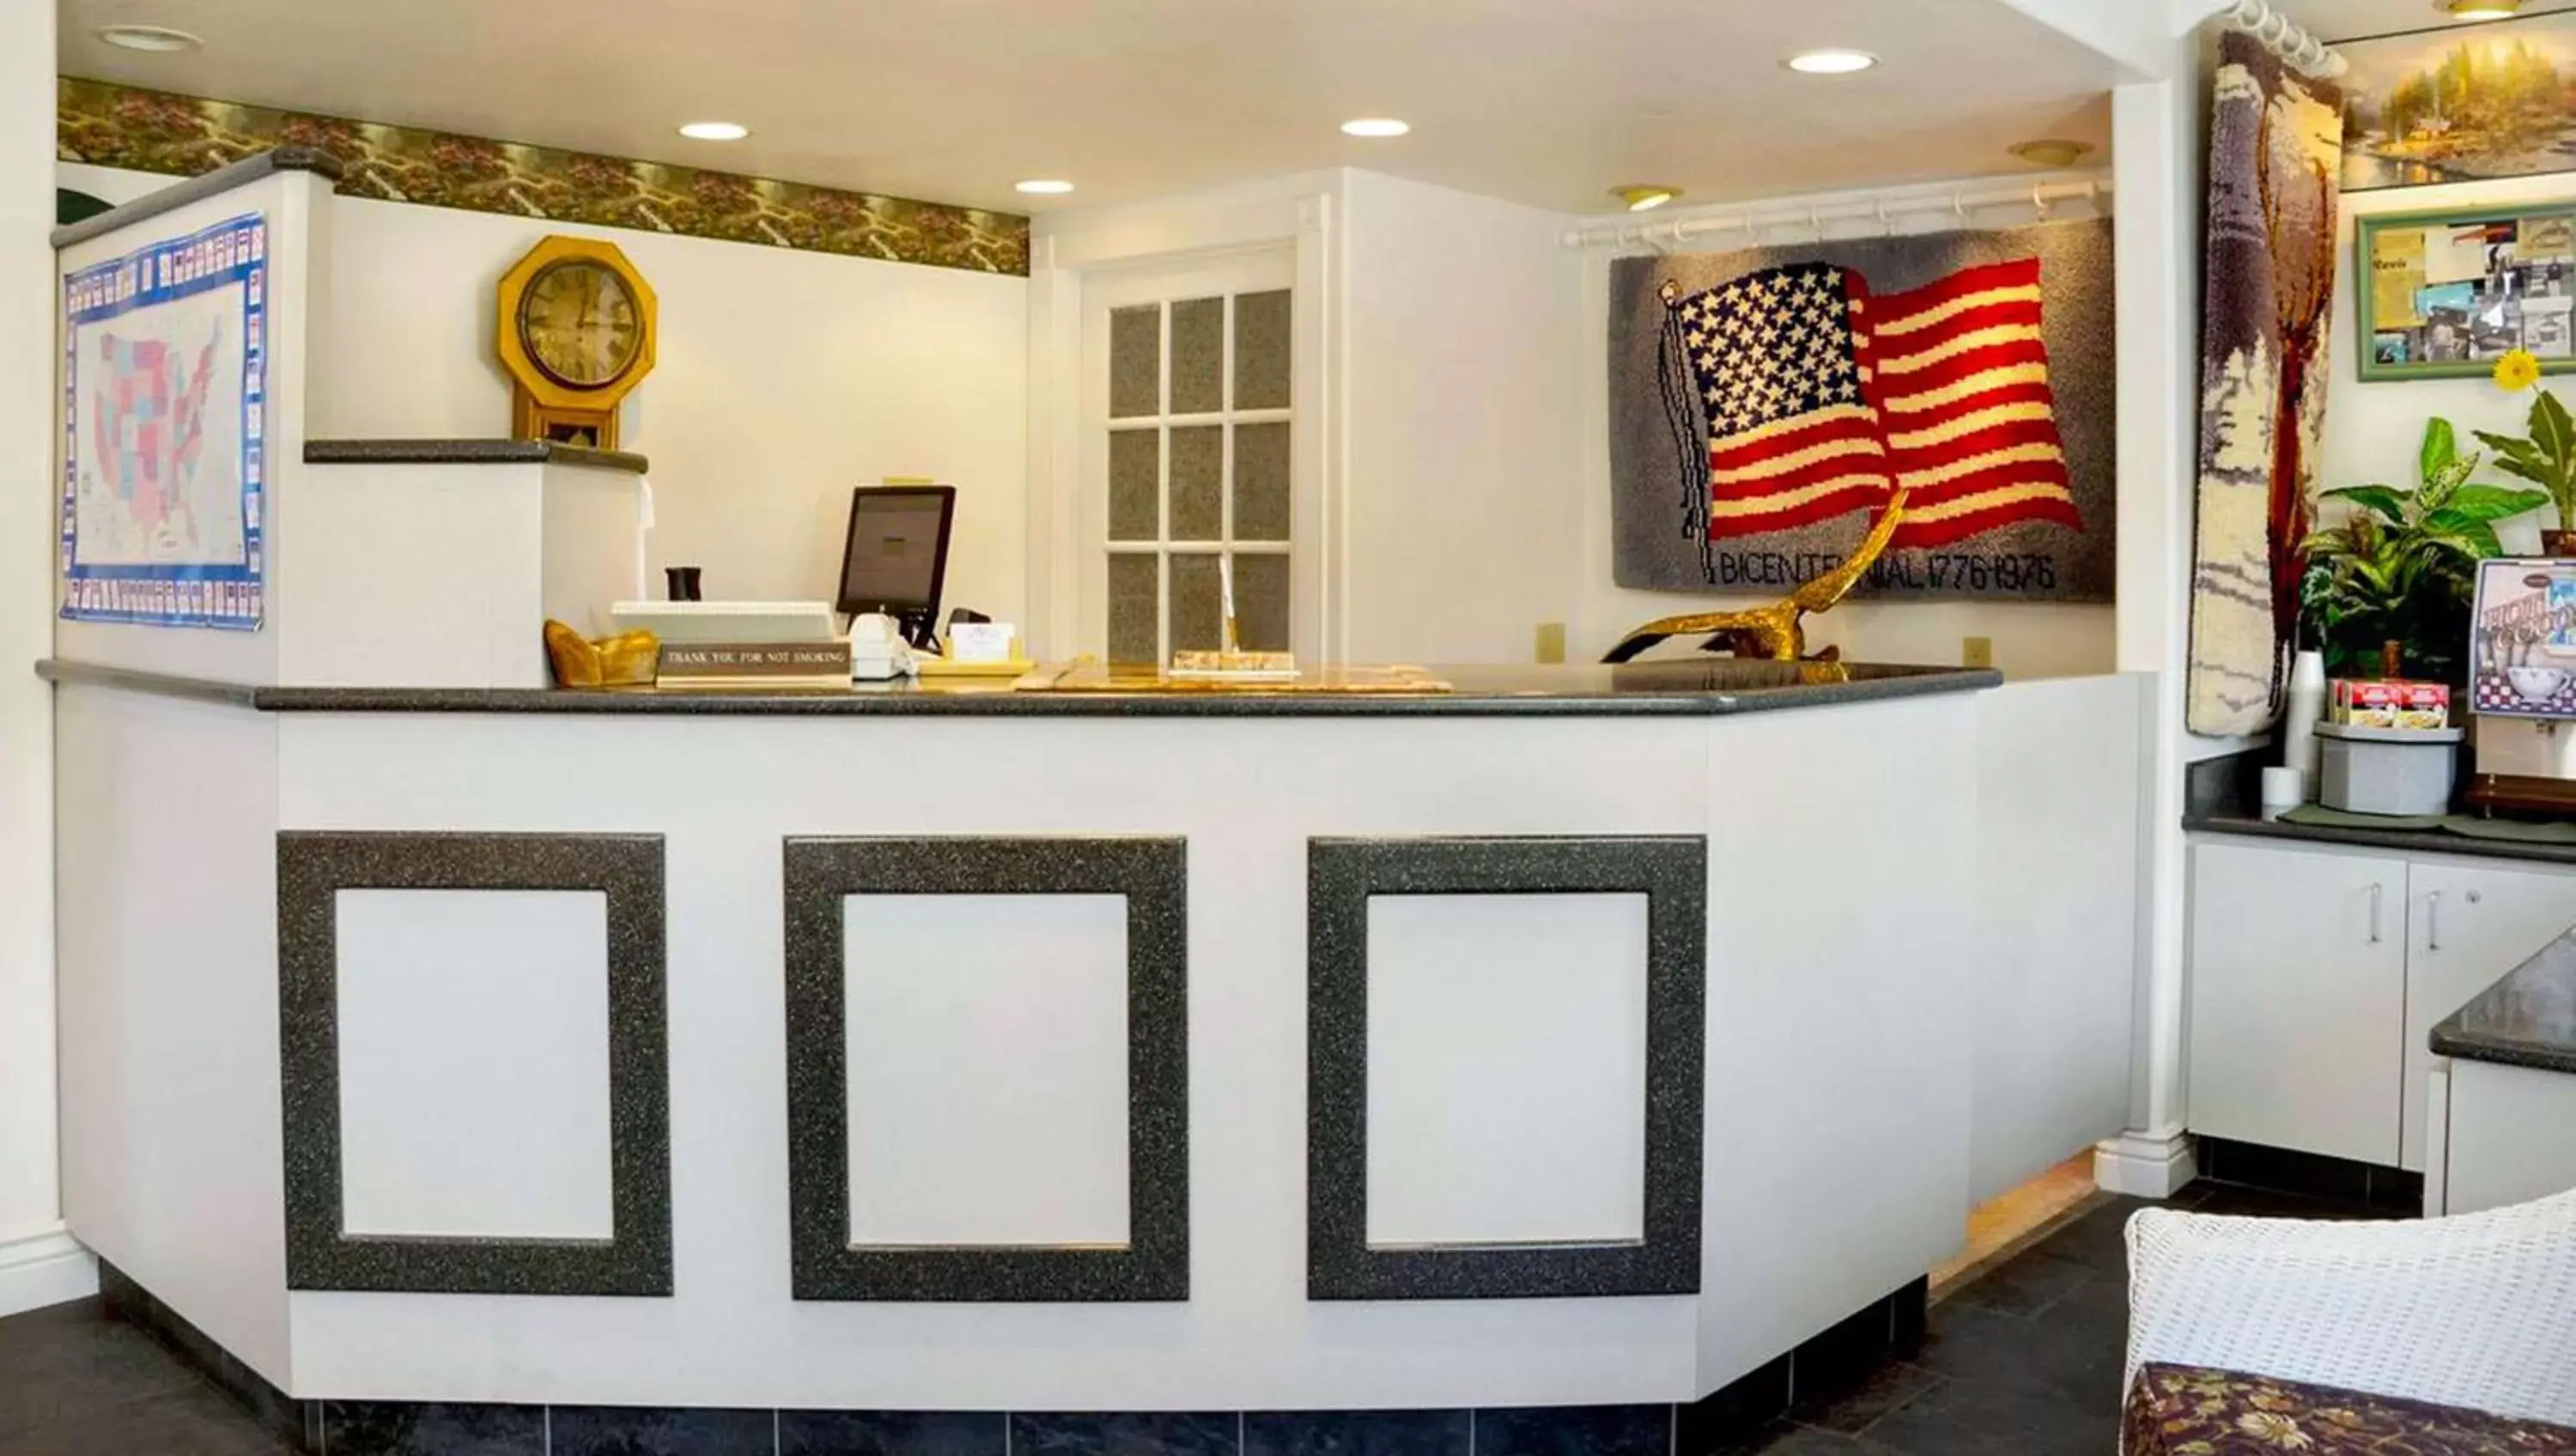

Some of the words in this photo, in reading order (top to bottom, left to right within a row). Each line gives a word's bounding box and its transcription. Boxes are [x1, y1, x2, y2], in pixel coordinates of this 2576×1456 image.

[669, 652, 707, 664] THANK
[712, 652, 735, 664] YOU
[740, 652, 763, 664] FOR
[768, 652, 790, 664] NOT
[793, 652, 846, 664] SMOKING
